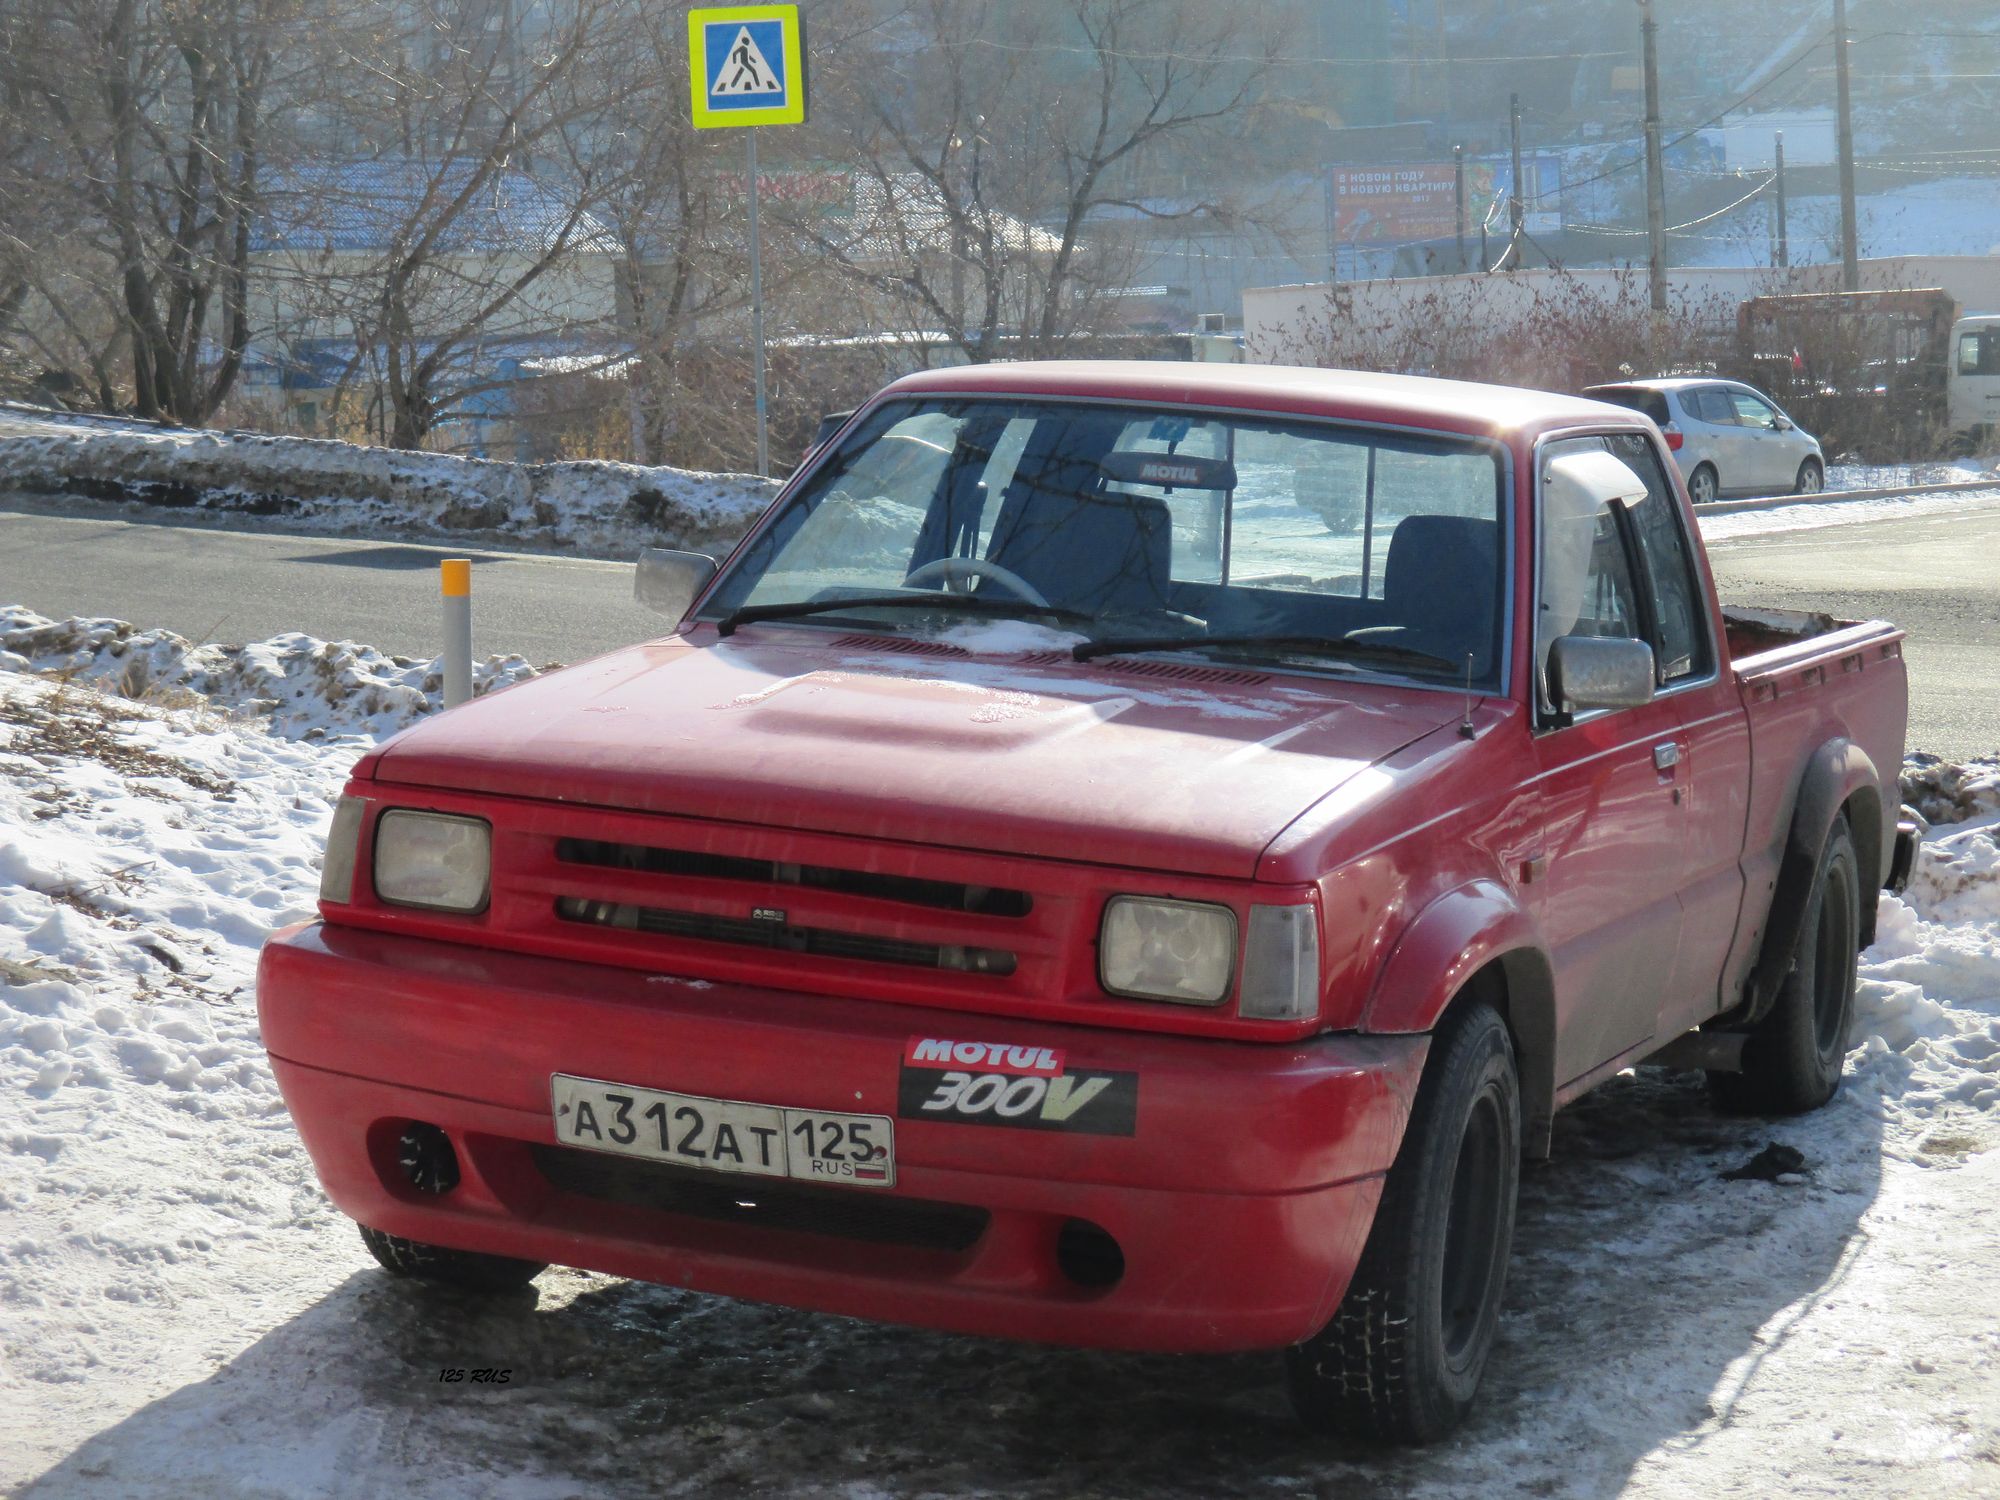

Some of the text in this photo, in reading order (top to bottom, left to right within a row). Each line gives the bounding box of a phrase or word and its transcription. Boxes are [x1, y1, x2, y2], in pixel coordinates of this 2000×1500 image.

[1339, 170, 1424, 183] В НОВОМ ГОДУ
[1339, 185, 1347, 195] В
[1350, 184, 1391, 195] НОВУЮ
[1141, 463, 1198, 480] MOTUL
[912, 1038, 1058, 1070] MOTUL
[921, 1072, 1112, 1121] 300V
[793, 1118, 875, 1161] 125
[812, 1159, 853, 1176] RUS
